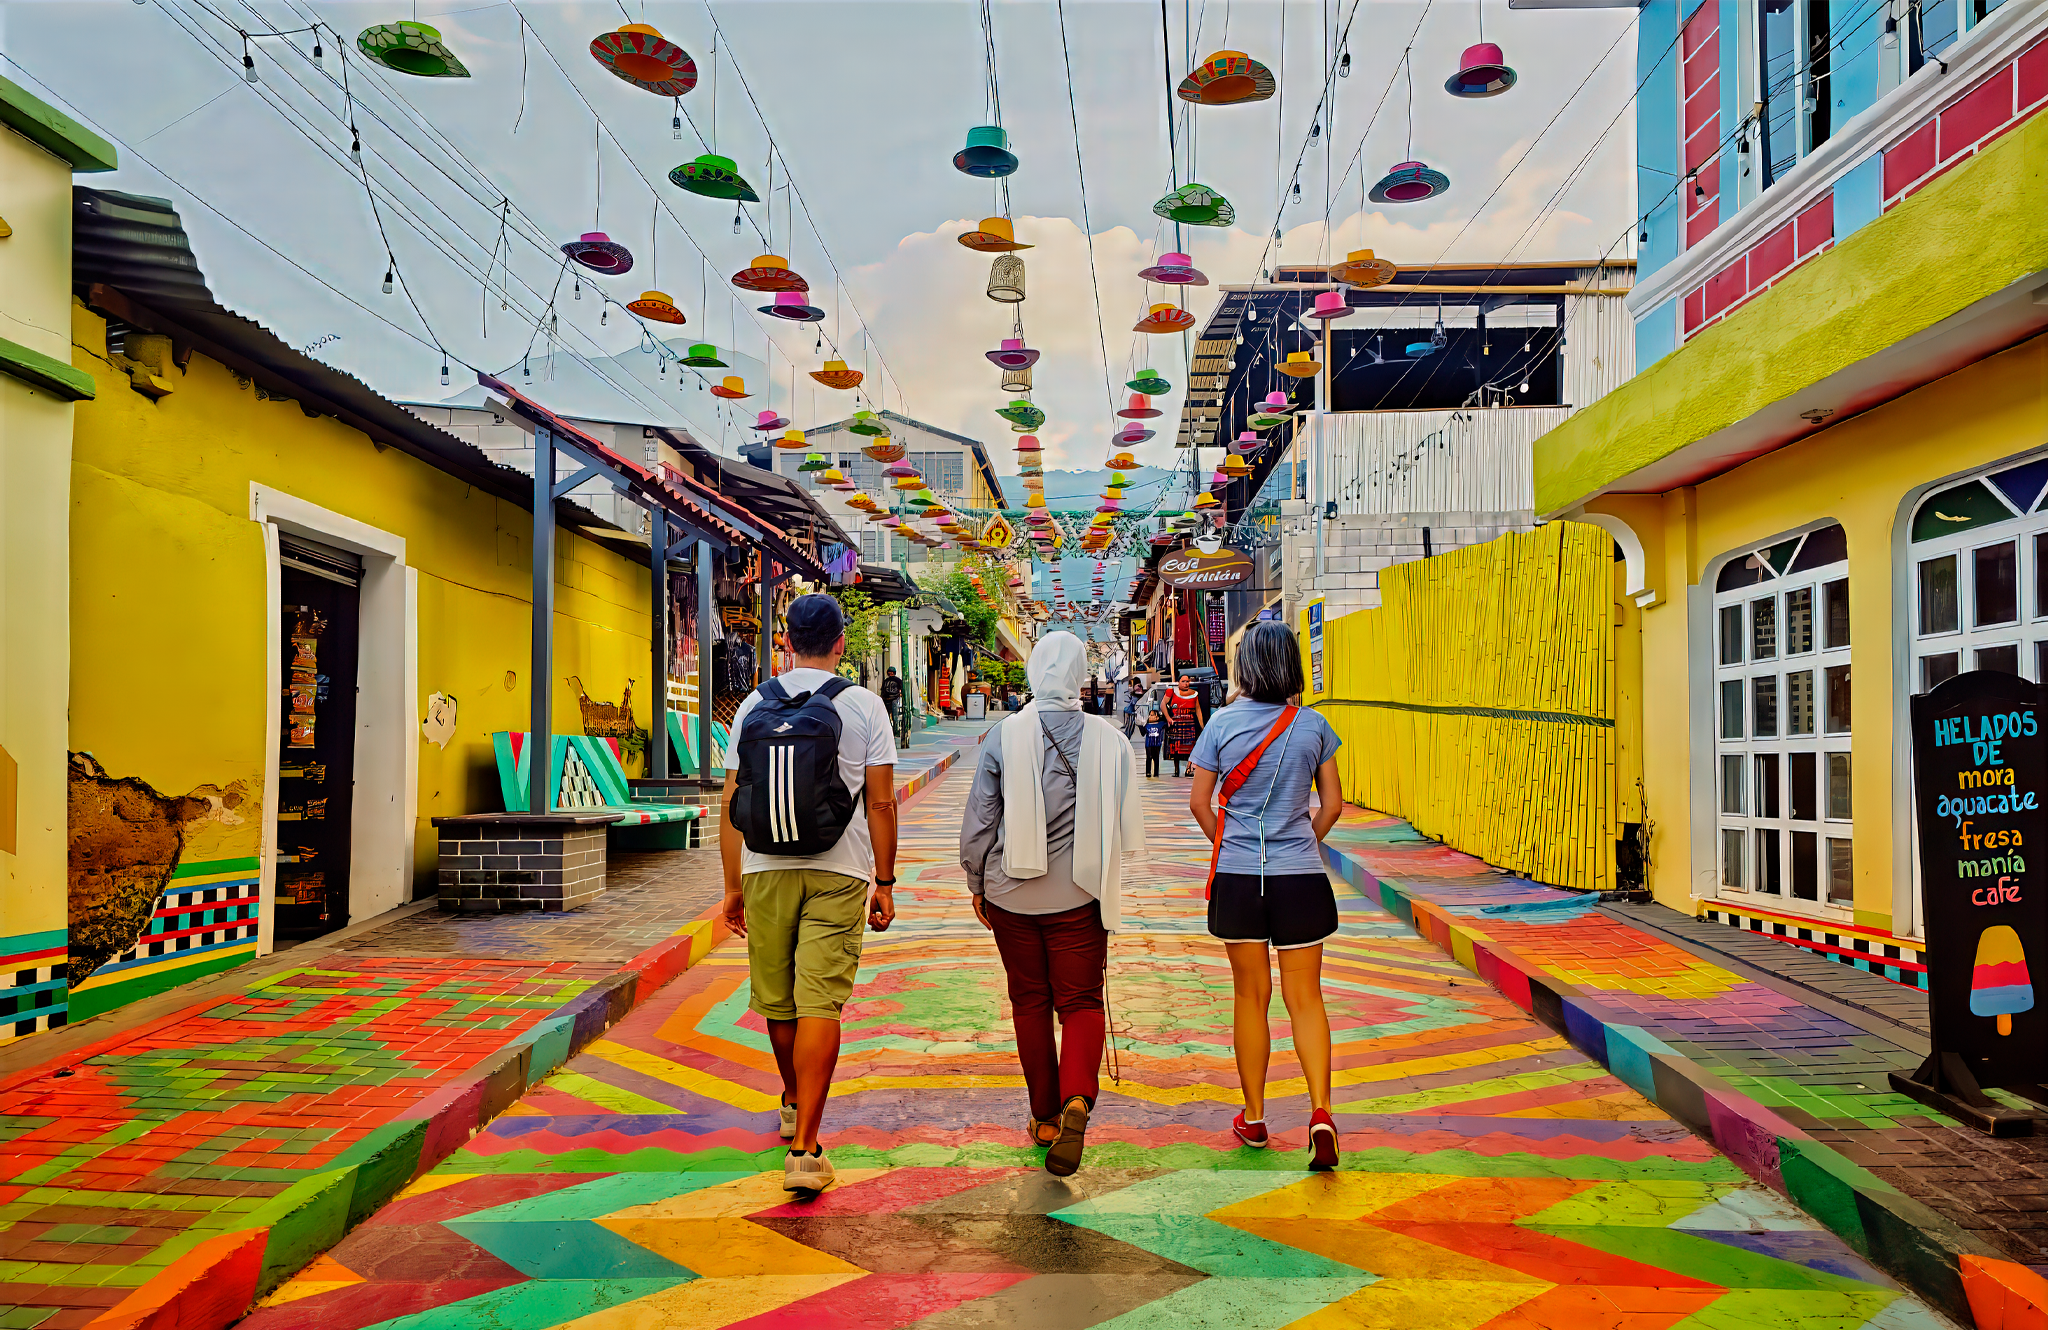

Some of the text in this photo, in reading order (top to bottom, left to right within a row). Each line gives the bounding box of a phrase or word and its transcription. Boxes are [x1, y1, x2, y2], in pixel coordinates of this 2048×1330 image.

[1934, 710, 2038, 747] HELADOS
[1972, 740, 2004, 766] DE
[1958, 768, 2015, 790] mora
[1936, 785, 2039, 829] aguacate
[1959, 821, 2023, 851] fresa
[1957, 848, 2026, 878] manía
[1971, 876, 2022, 906] café
